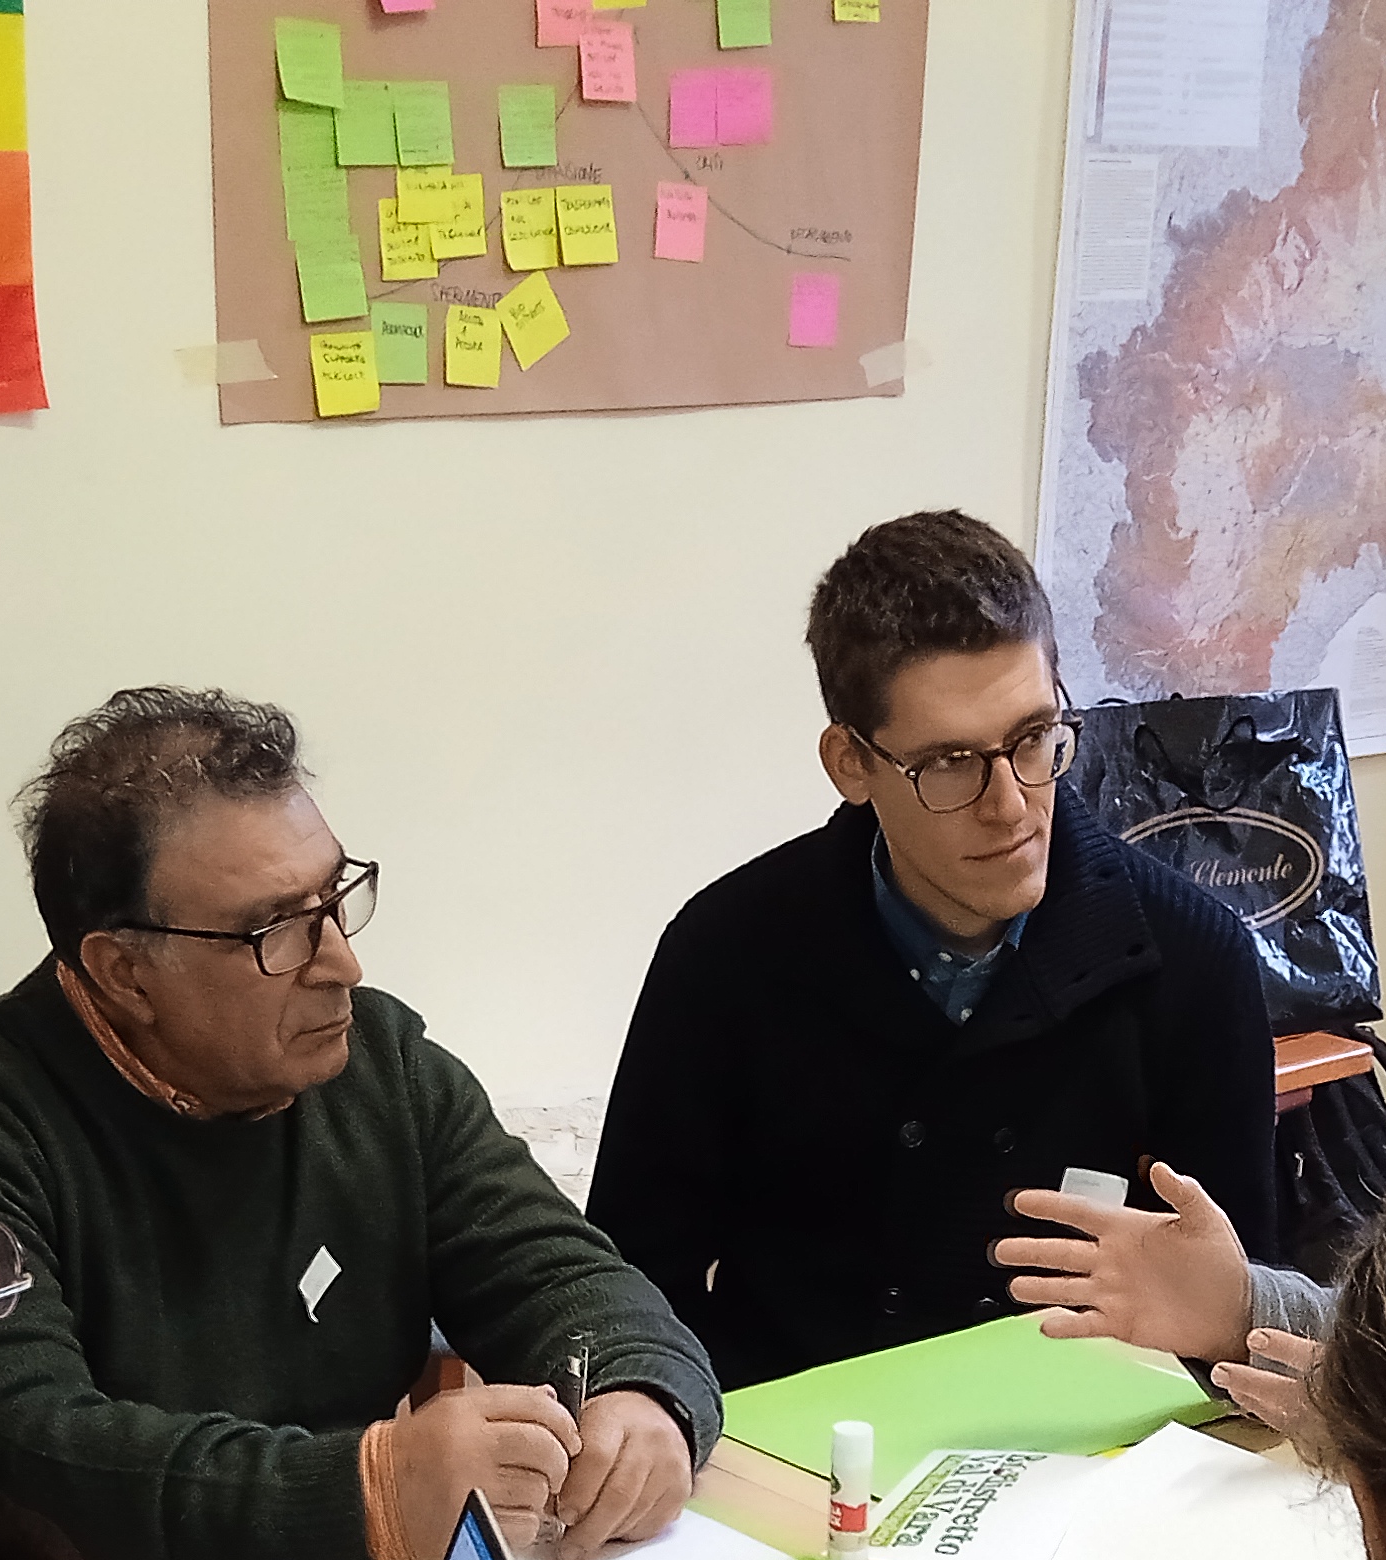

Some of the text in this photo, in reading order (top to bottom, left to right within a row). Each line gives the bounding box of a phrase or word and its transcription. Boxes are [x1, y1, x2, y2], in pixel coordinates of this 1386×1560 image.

[1190, 853, 1293, 887] Clemente
[950, 1454, 1006, 1476] Val
[933, 1479, 979, 1496] di
[892, 1496, 963, 1547] Vara
